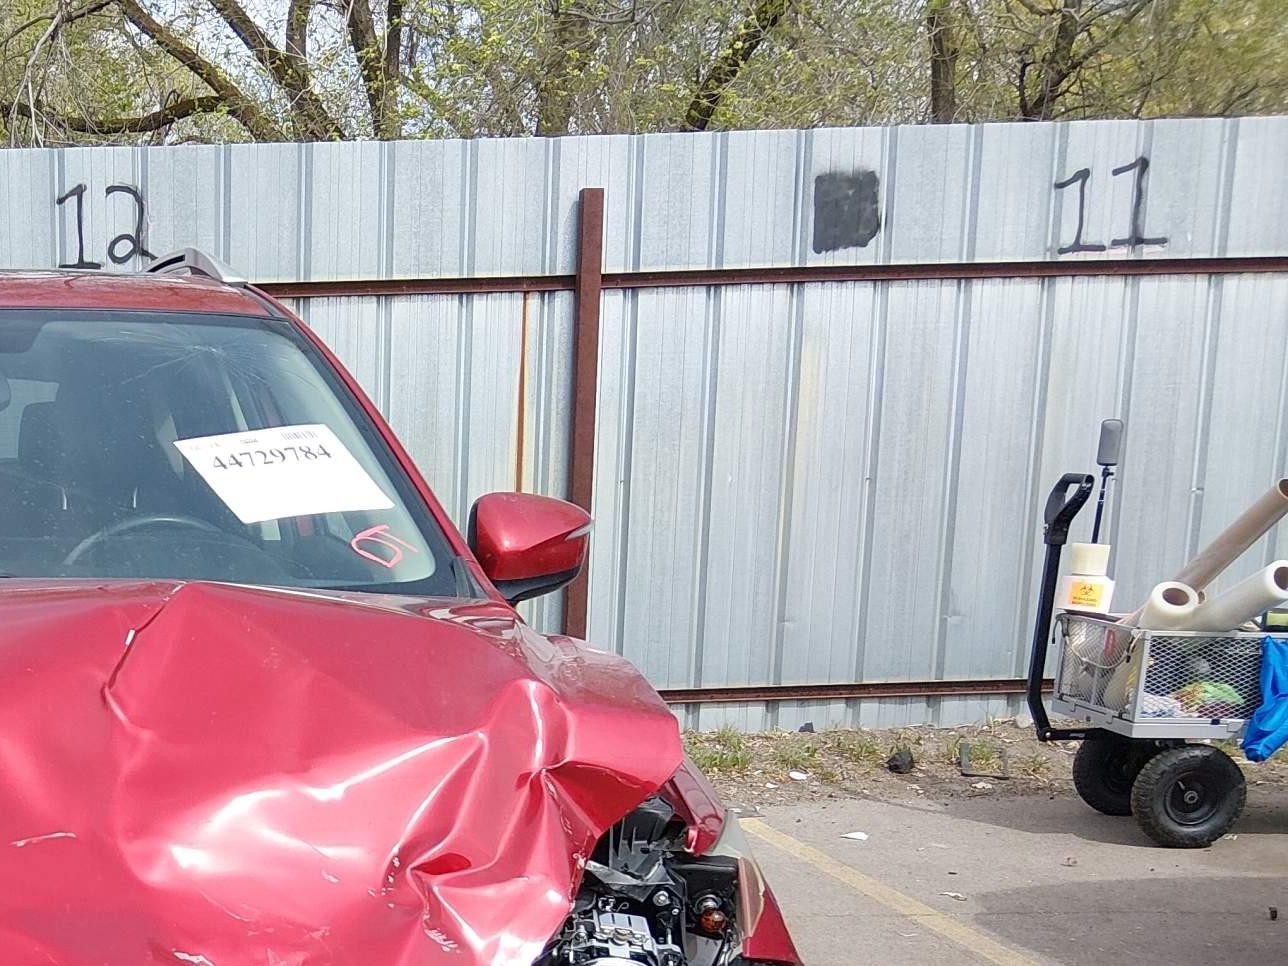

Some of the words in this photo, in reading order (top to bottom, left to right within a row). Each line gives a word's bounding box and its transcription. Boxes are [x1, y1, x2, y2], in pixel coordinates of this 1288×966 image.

[56, 183, 158, 270] 12
[1054, 156, 1168, 255] 11
[213, 443, 332, 470] 44729784
